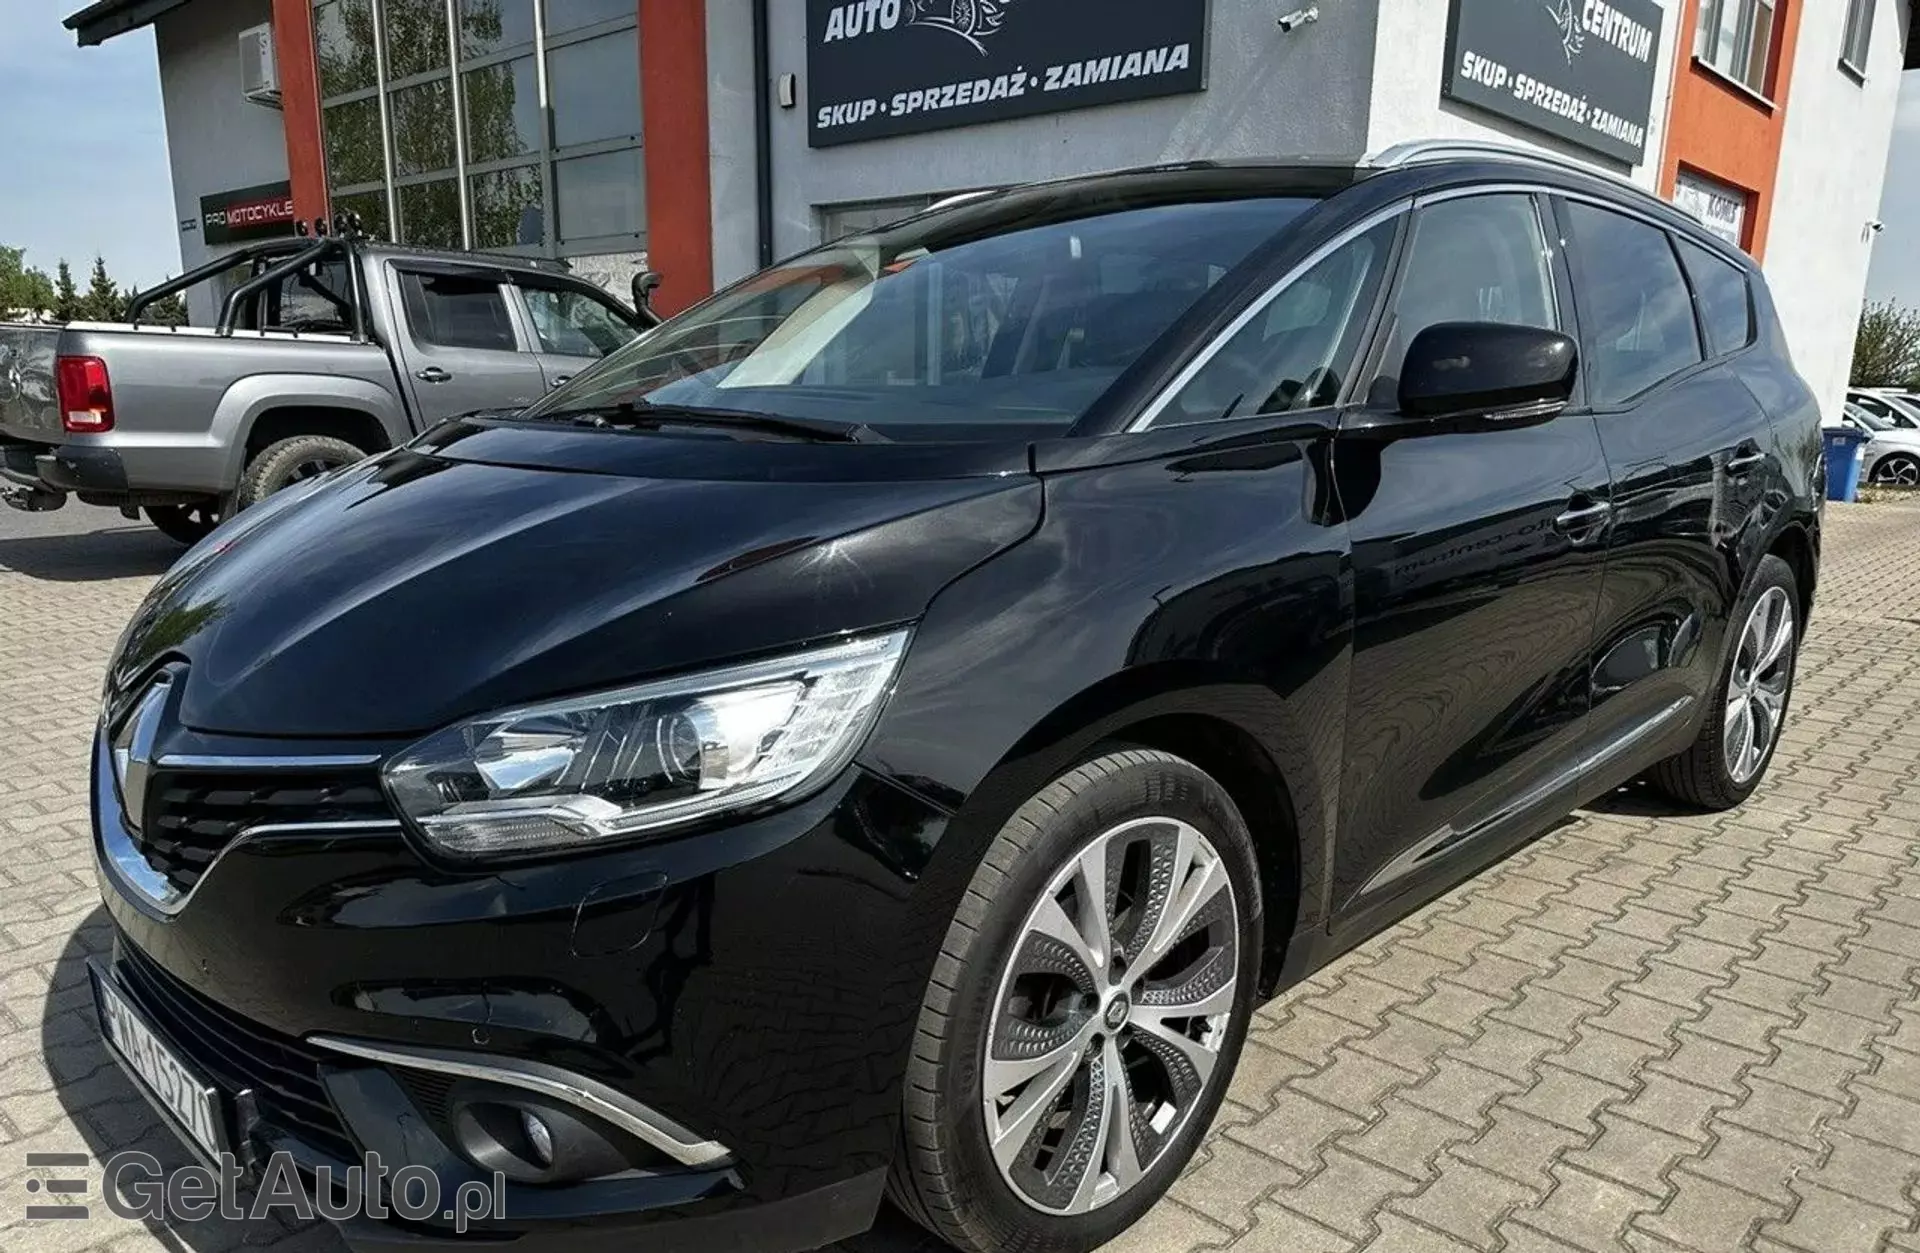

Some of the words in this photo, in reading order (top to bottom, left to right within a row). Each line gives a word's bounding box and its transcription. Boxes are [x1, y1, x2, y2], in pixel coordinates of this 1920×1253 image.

[824, 0, 900, 42] AUTO
[1582, 0, 1652, 62] CENTRUM
[817, 98, 875, 129] SKUP
[889, 65, 1027, 116] SPRZEDAŻ
[1044, 43, 1190, 91] ZAMIANA
[1461, 51, 1507, 90] SKUP
[1513, 75, 1587, 125] SPRZEDAŻ
[1591, 109, 1644, 148] ZAMIANA
